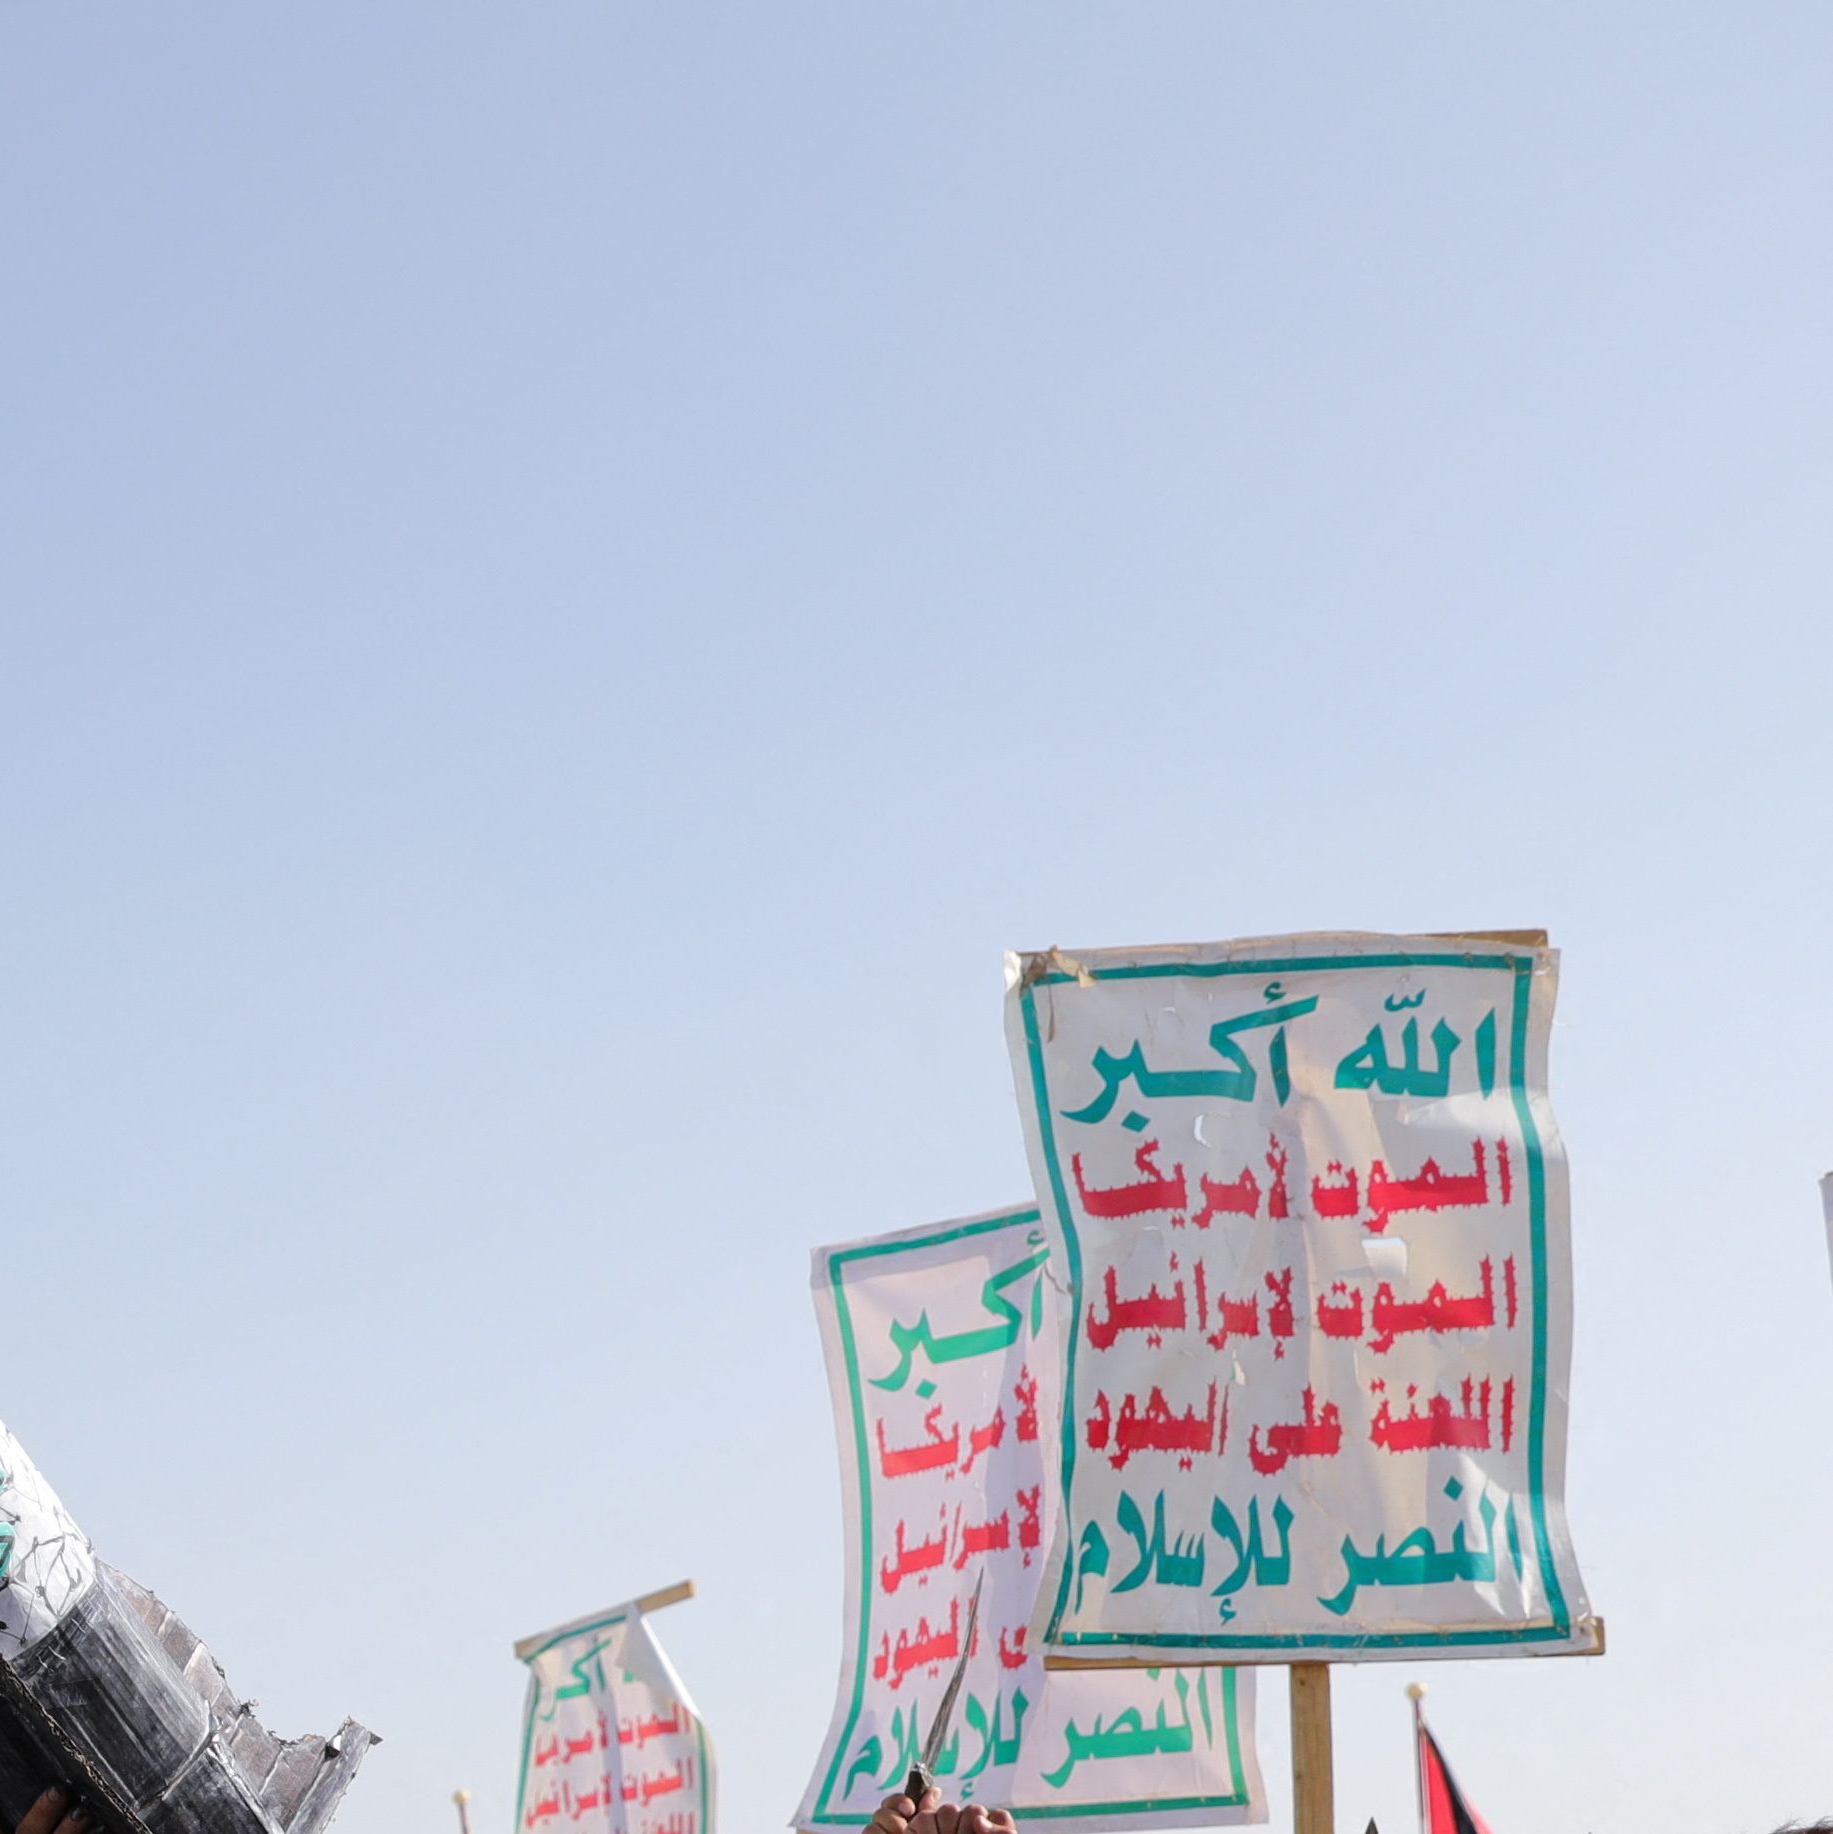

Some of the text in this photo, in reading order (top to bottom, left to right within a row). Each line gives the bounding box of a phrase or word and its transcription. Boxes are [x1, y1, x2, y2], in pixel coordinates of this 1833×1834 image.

[1059, 981, 1495, 1132] الله أكبر
[1072, 1132, 1513, 1234] الموت لأمريكا
[869, 1229, 1051, 1400] أكبر
[1087, 1252, 1518, 1359] الموت لإسرائيل
[876, 1362, 1039, 1480] لأمريكا
[1087, 1374, 1514, 1476] اللعنة على اليهود
[880, 1483, 1041, 1594] لإسرائيل
[1076, 1475, 1526, 1626] النصر للإسلام
[873, 1596, 978, 1690] اليهود
[617, 1703, 693, 1750] الموت
[621, 1756, 696, 1806] الموت
[1041, 1668, 1215, 1789] النصر
